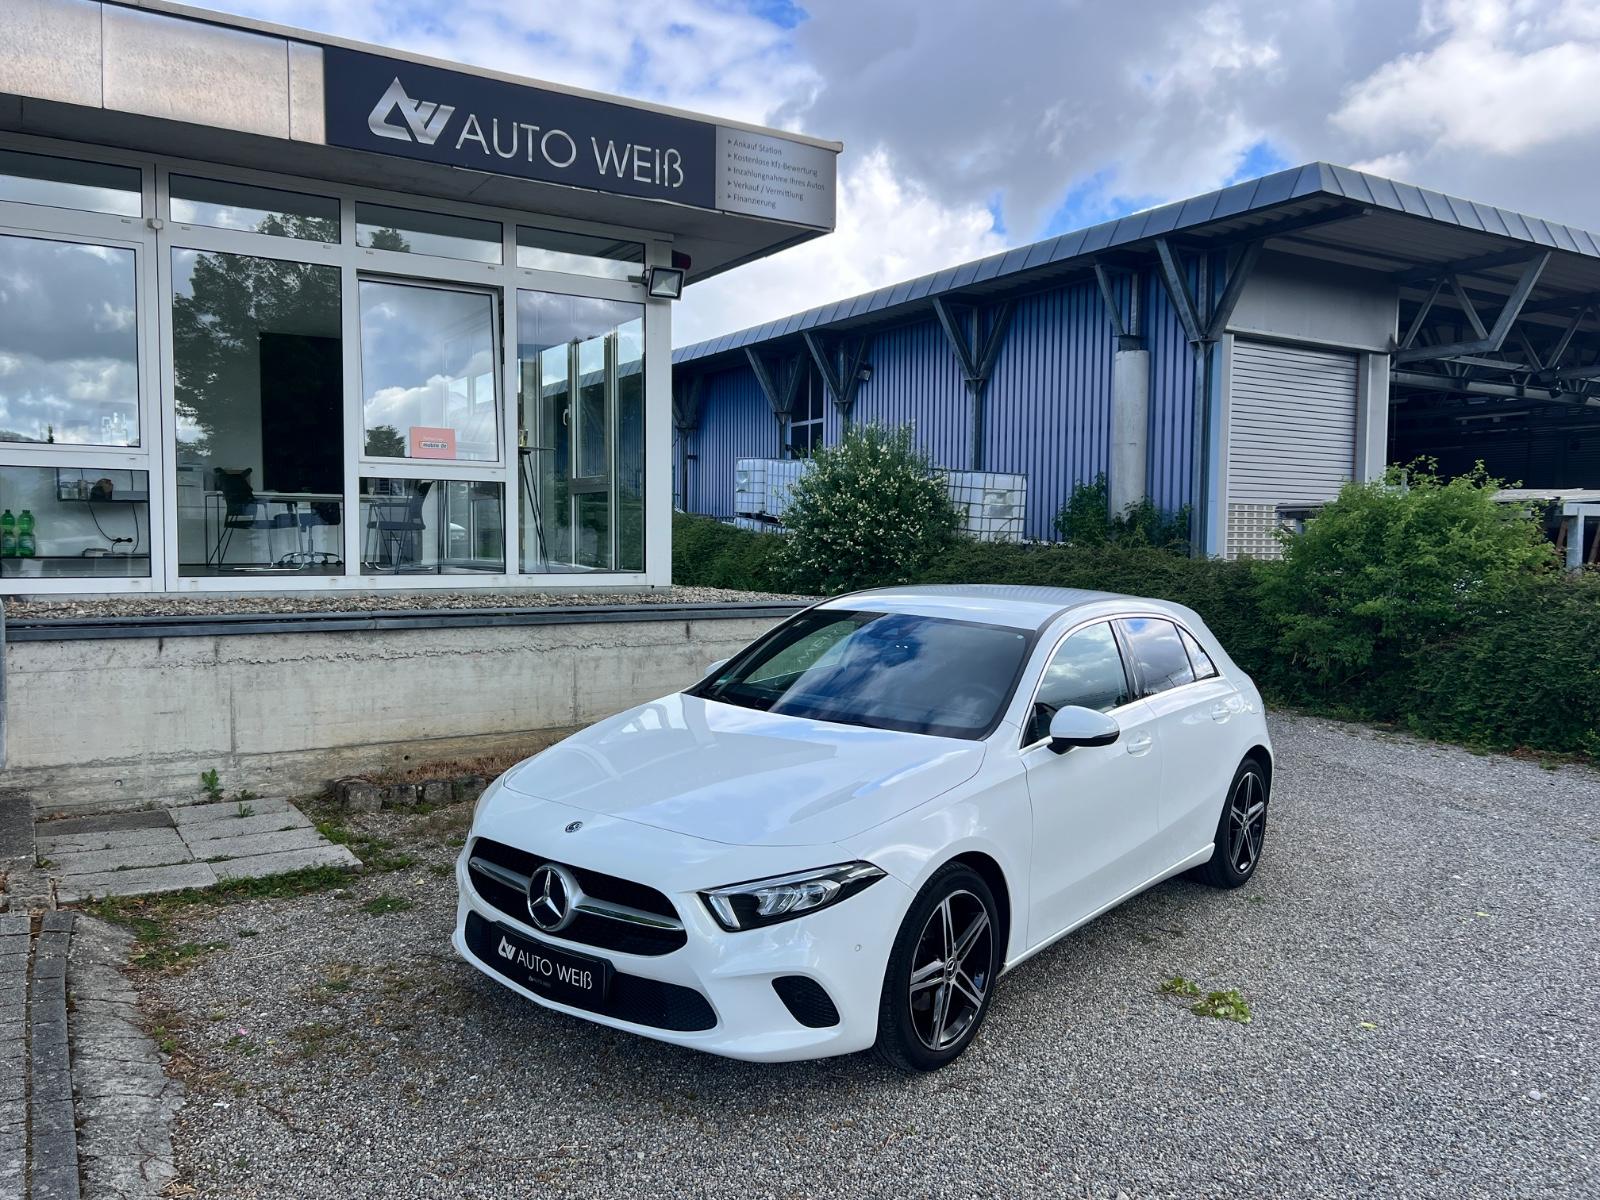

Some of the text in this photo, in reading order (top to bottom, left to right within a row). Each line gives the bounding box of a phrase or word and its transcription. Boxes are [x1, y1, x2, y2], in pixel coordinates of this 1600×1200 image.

[455, 113, 577, 168] AUTO
[591, 136, 684, 188] WEIß
[733, 140, 782, 156] Ankauf Station
[733, 153, 770, 168] Kostenlose
[733, 167, 825, 191] Inzahlungnahme Ihres Autos
[733, 181, 759, 192] Verkauf
[766, 187, 804, 201] Vermittlung
[733, 193, 777, 209] Finanzierung
[517, 949, 553, 976] AUTO
